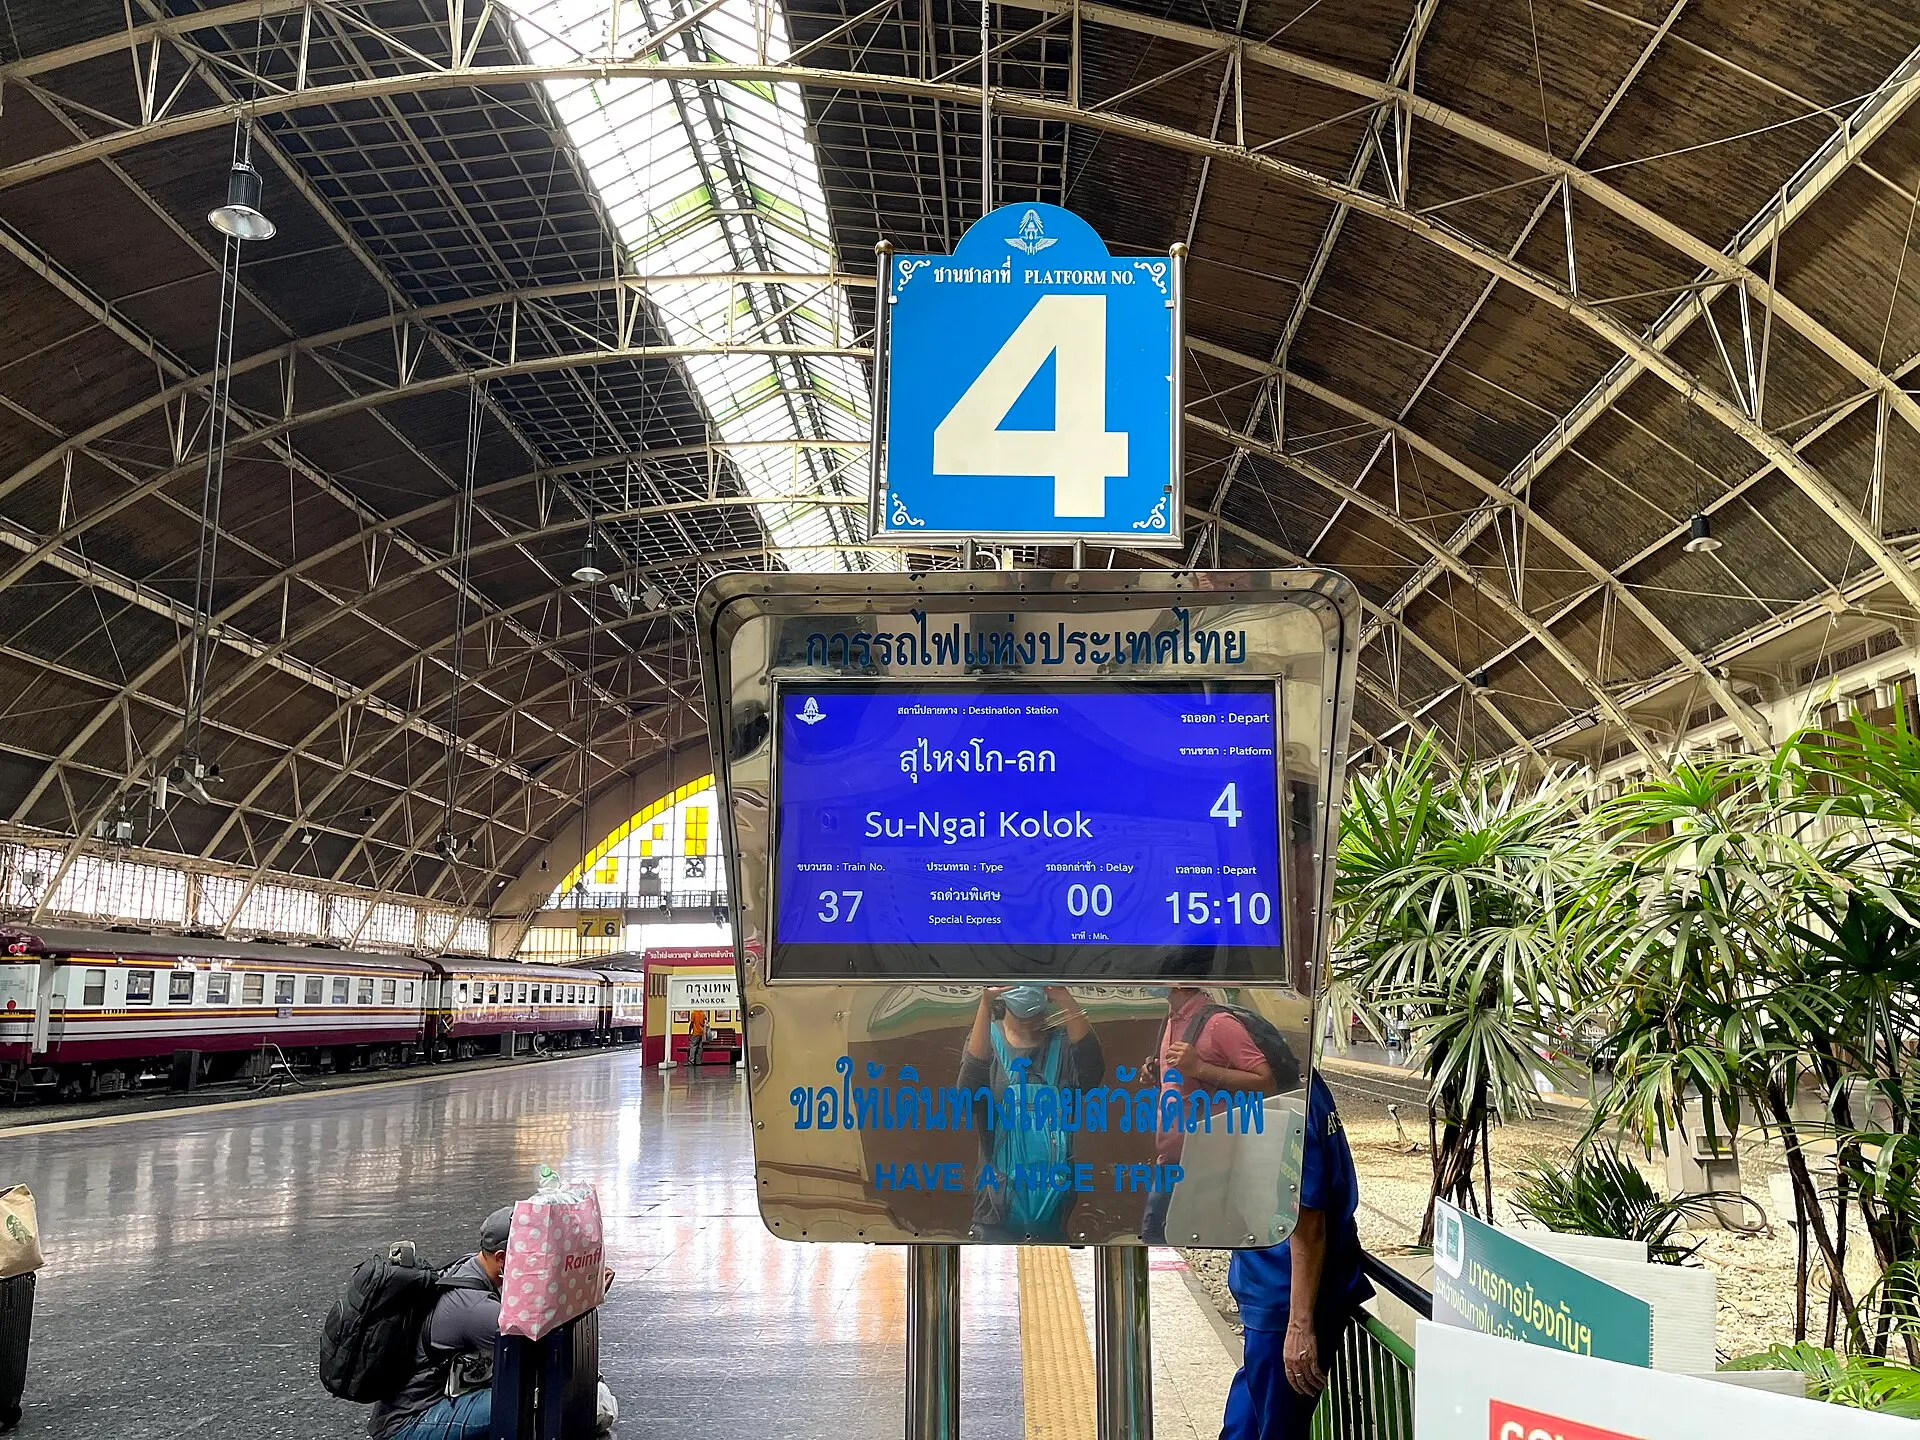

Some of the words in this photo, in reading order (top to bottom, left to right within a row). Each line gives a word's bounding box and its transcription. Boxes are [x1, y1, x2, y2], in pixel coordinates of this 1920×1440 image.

[934, 255, 1011, 284] ชานชาลาที่
[1024, 269, 1106, 285] PLATFORM
[1111, 271, 1136, 285] NO.
[932, 294, 1129, 518] 4
[806, 606, 1246, 666] การรถไฟแห่งประเทศไทย
[897, 705, 958, 716] สถานีปลายทาง
[968, 706, 1021, 716] Destination
[1025, 706, 1059, 716] Station
[1180, 714, 1216, 723] รถออก
[1228, 713, 1270, 725] Depart
[1179, 746, 1219, 755] ชานชาลา
[1229, 746, 1272, 756] Platform
[900, 737, 1056, 784] สุไหงโก-ลก
[1209, 782, 1243, 828] 4
[865, 811, 985, 845] Su-Ngai
[999, 811, 1094, 838] Kolok
[797, 862, 832, 872] ขบวนรถ
[842, 862, 866, 872] Train
[869, 862, 886, 872] No.
[926, 862, 969, 872] ประเภทรถ
[979, 862, 1003, 874] Type
[1045, 860, 1096, 872] รถออกล่าช้า
[1106, 863, 1134, 874] Delay
[1175, 866, 1213, 875] เวลาออก
[1223, 865, 1257, 876] Depart
[930, 886, 1001, 902] รถด่วนพิเศษ
[1067, 884, 1113, 917] 00
[817, 890, 864, 923] 37
[1165, 891, 1272, 925] 15:10
[582, 921, 593, 936] 7
[604, 921, 616, 936] 6
[928, 915, 963, 926] Special
[966, 915, 1002, 926] Express
[1071, 930, 1086, 940] นาที
[686, 983, 731, 996] กรุงเทพ
[790, 1056, 1265, 1135] ขอให้เดินทางโดยสวัสดิภาพ
[875, 1163, 963, 1192] HAVE
[977, 1163, 999, 1192] A
[1015, 1163, 1094, 1192] NICE
[1115, 1163, 1185, 1193] TRIP
[1468, 1258, 1593, 1357] มาตรการป้องกันฯ
